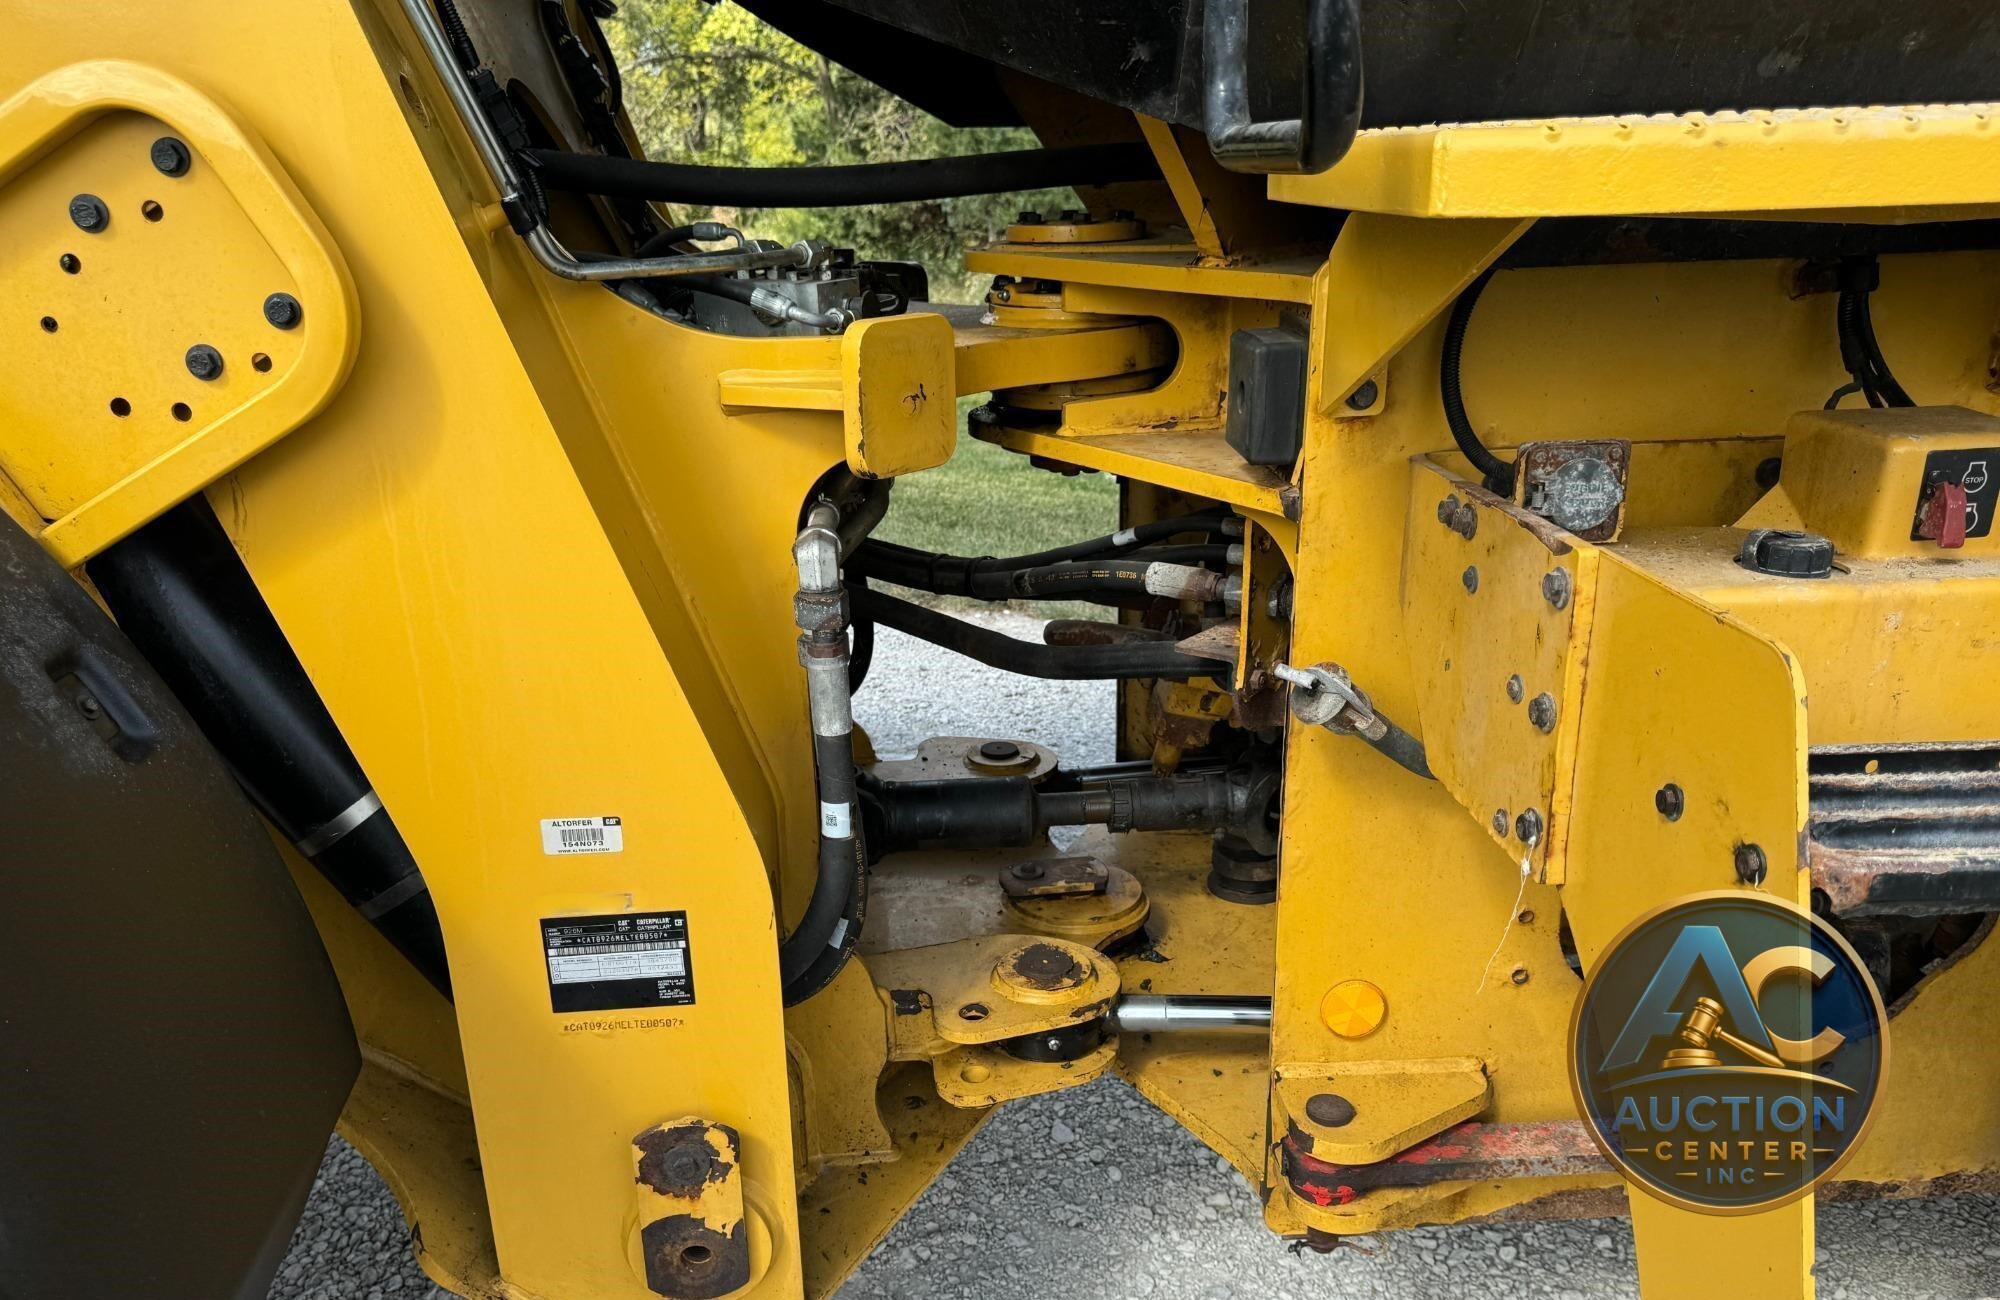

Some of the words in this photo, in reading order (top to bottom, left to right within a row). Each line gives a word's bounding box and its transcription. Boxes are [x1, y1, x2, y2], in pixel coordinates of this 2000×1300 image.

[1965, 476, 1984, 484] STOP
[552, 819, 593, 827] ALTORFER
[562, 840, 604, 848] 154N073
